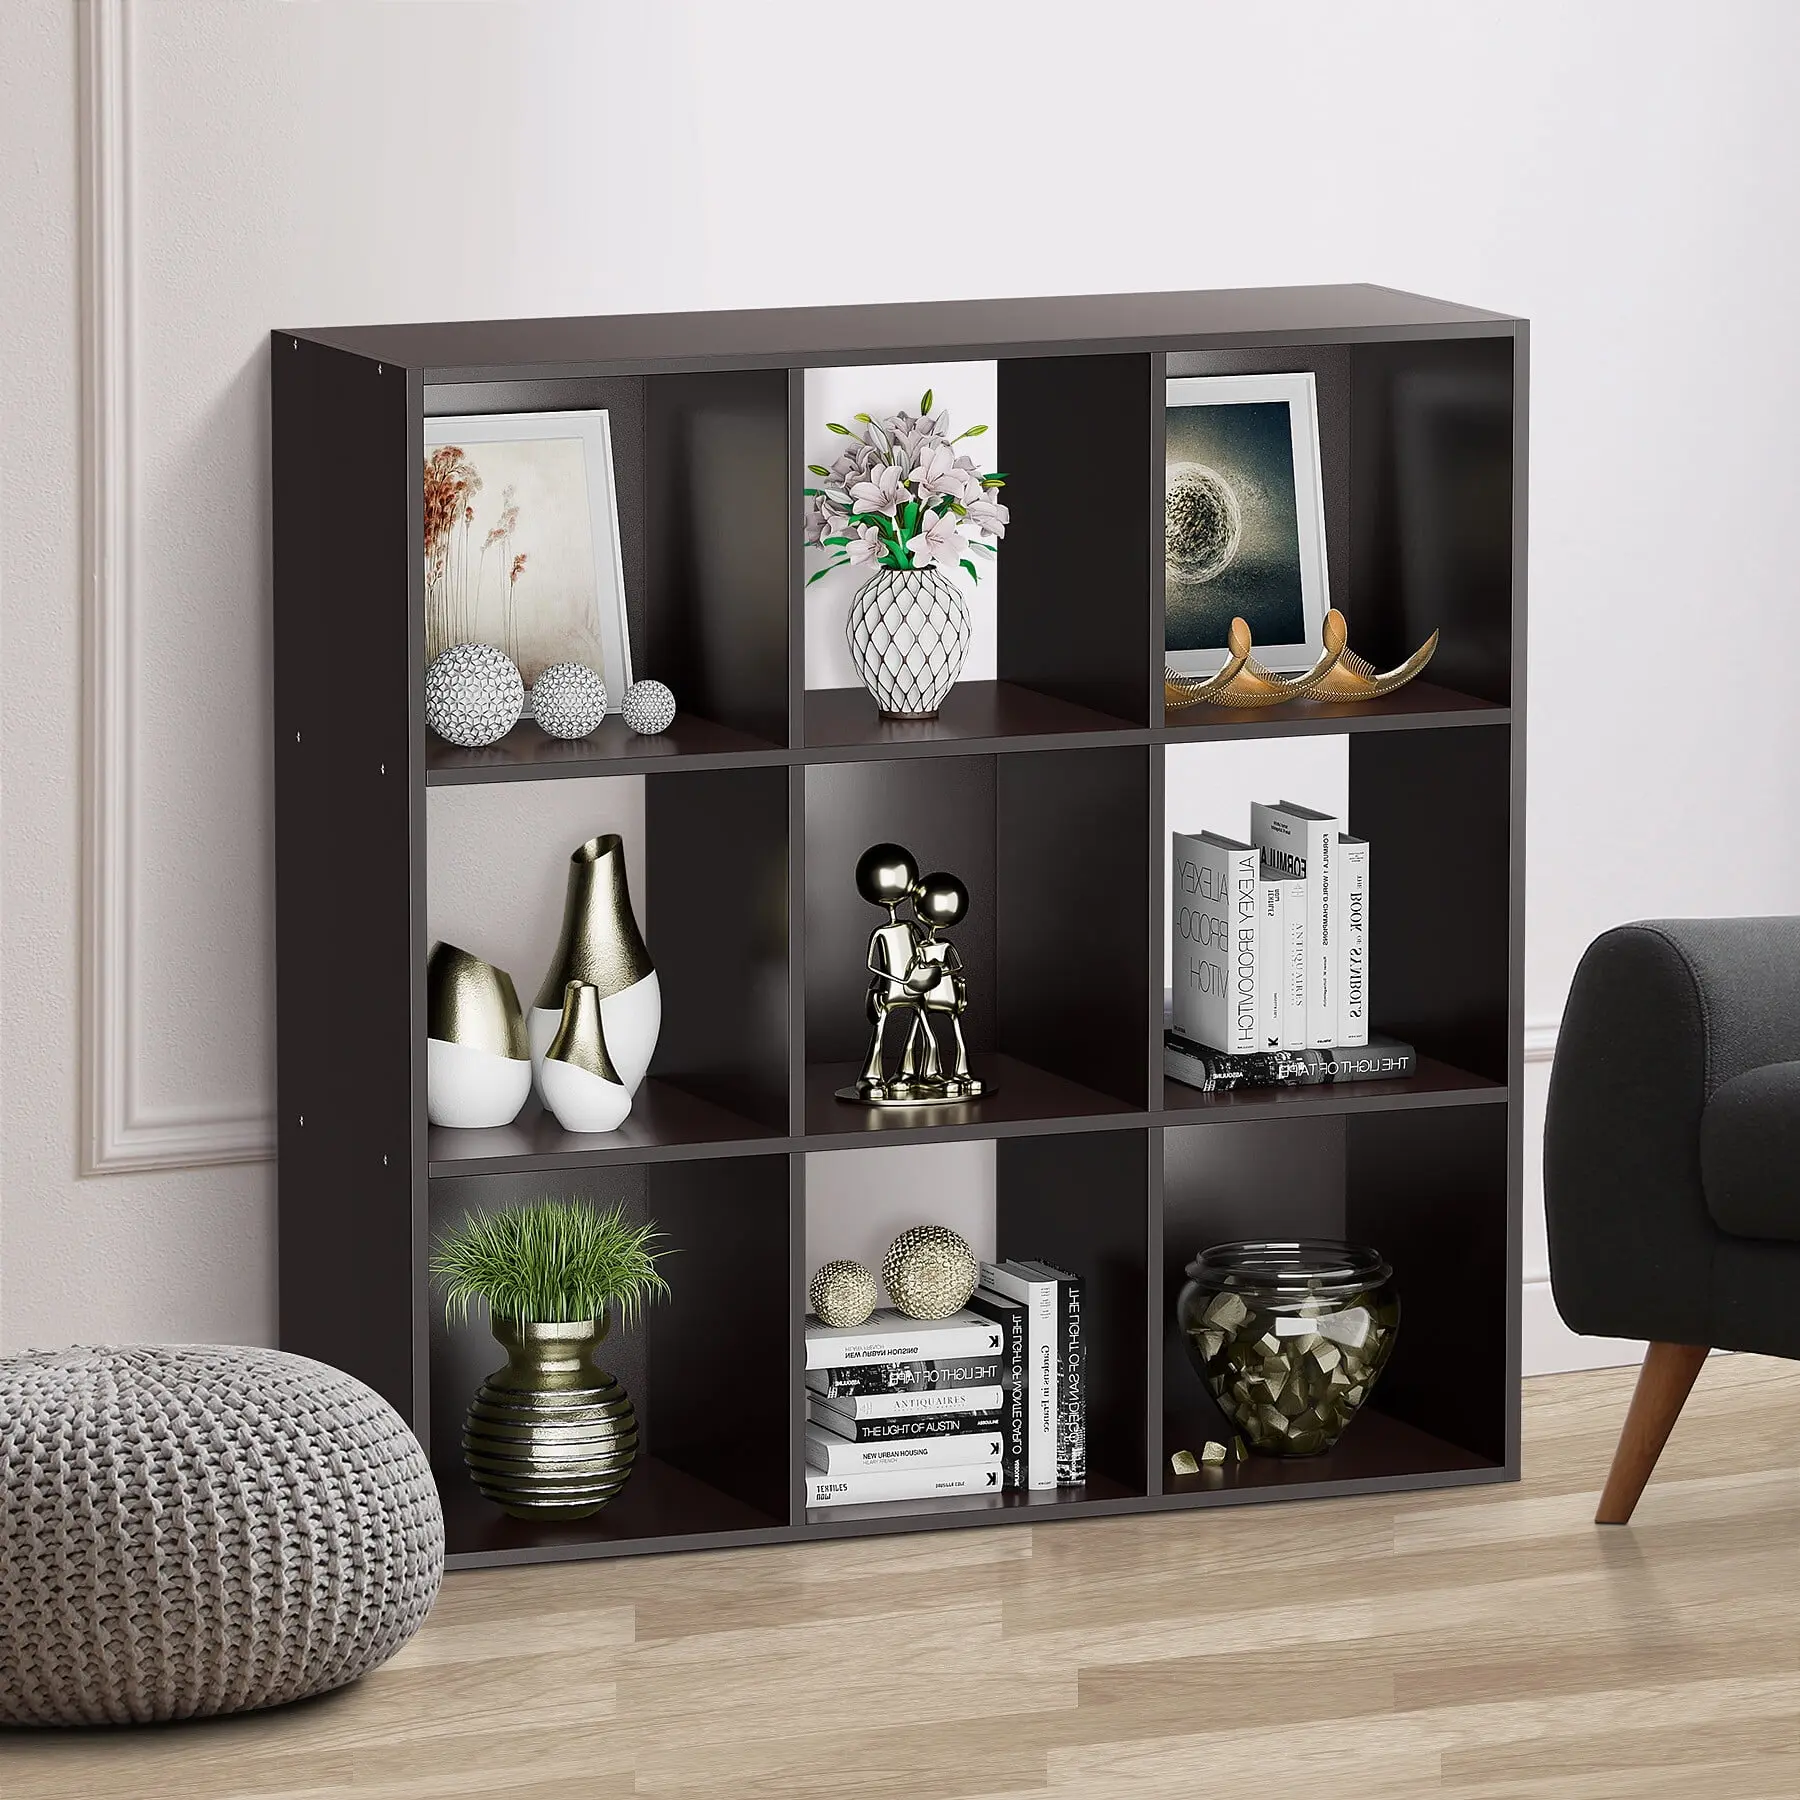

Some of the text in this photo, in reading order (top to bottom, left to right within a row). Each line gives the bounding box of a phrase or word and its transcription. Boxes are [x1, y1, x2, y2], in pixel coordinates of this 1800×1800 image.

[894, 1395, 966, 1409] ANTIQUAIRES
[862, 1420, 960, 1437] THE LIGHT OF AUSTIN
[862, 1448, 928, 1461] NEW URBAN HOUSING
[816, 1483, 848, 1493] TEXTILES
